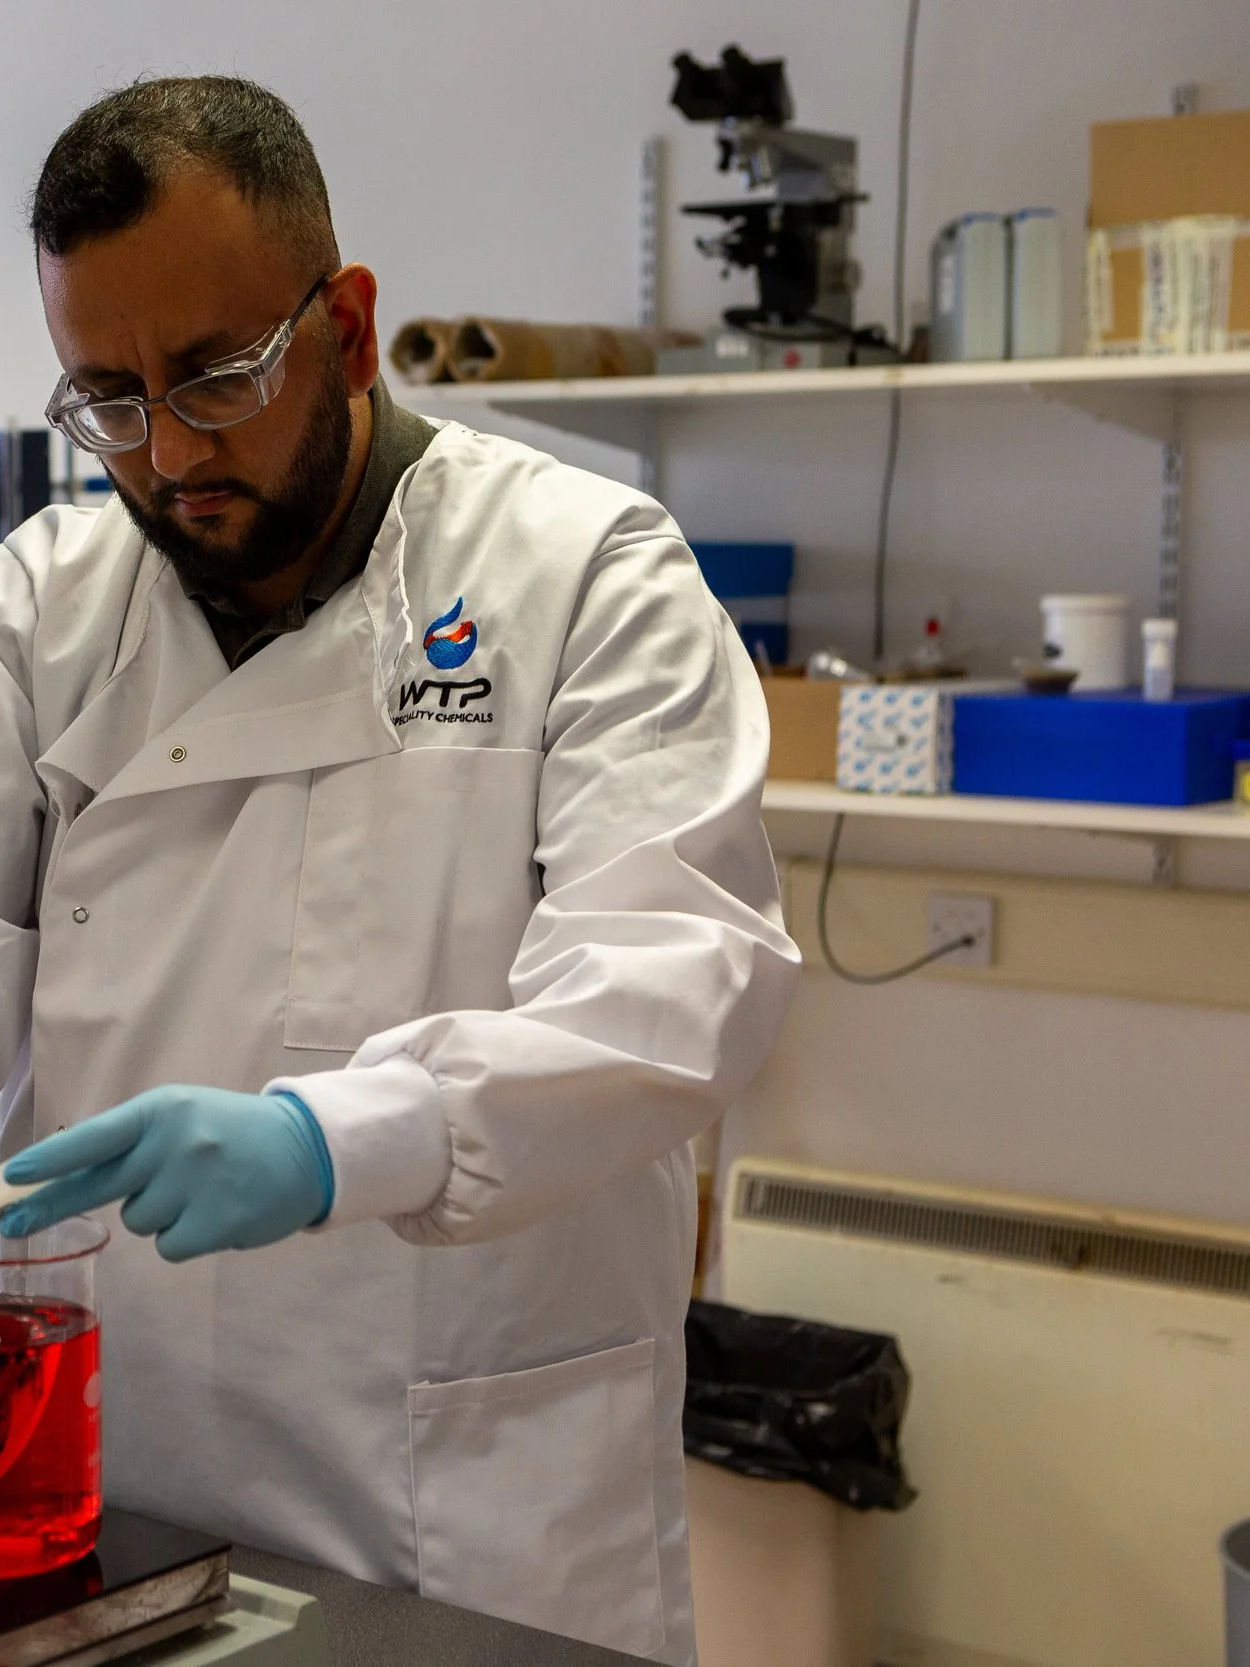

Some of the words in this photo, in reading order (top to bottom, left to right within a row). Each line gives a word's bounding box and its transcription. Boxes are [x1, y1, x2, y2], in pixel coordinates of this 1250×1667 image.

[399, 677, 492, 711] WTP
[392, 710, 434, 726] PECIALITY
[435, 712, 493, 724] CHEMICALS
